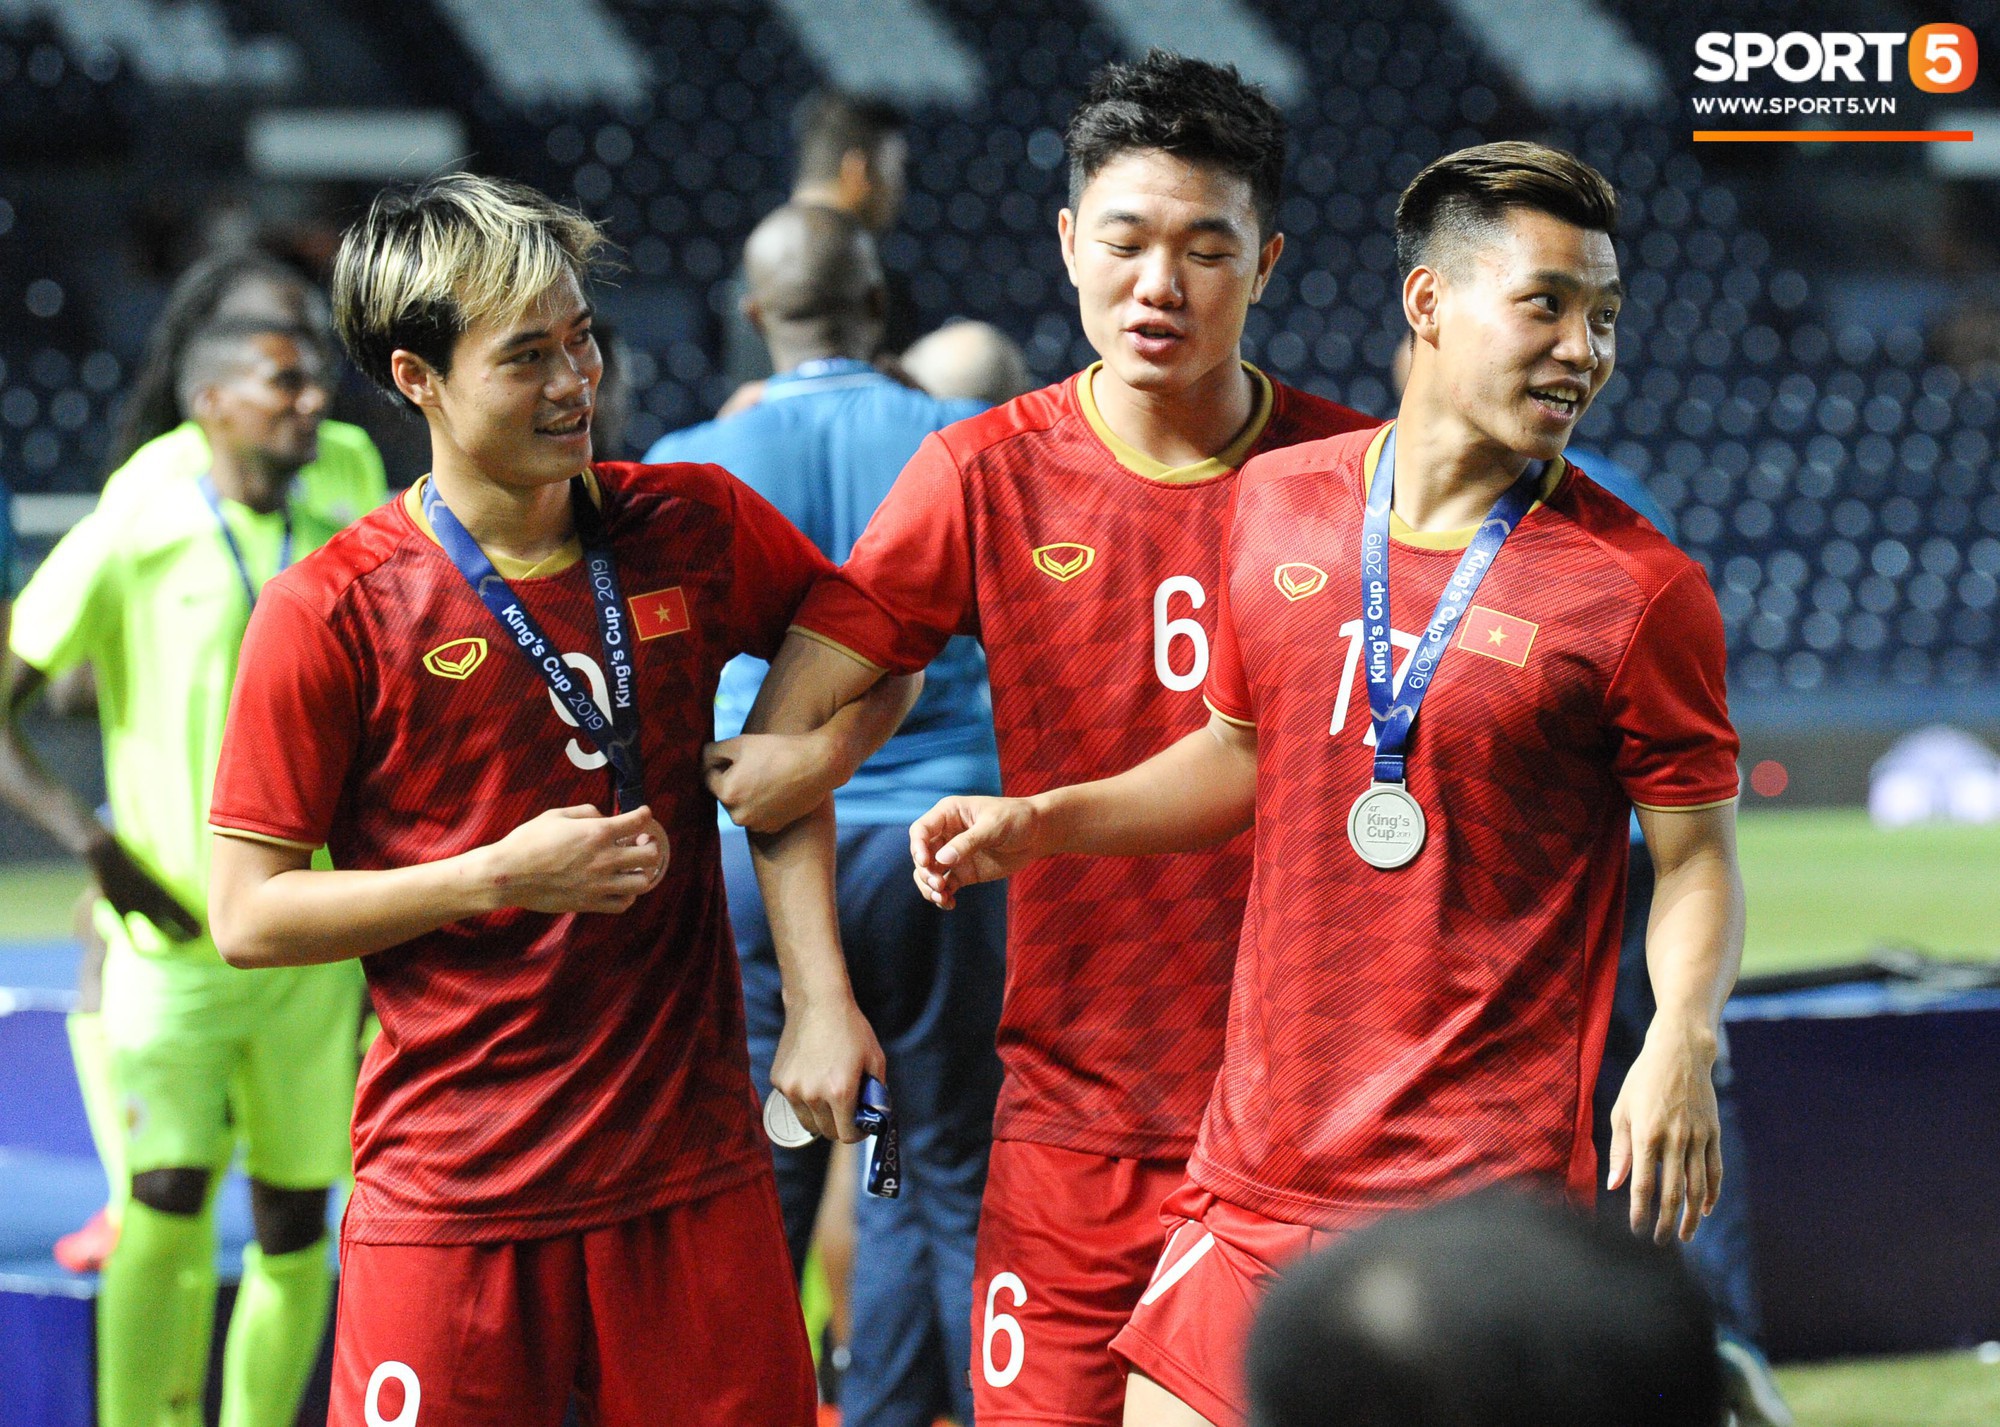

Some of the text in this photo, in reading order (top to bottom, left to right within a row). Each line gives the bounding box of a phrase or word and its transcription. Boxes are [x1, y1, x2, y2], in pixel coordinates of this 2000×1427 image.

[1366, 533, 1382, 575] 2019
[591, 559, 615, 602] 2019
[1367, 580, 1386, 620] Cup
[605, 606, 621, 645] Cup
[1153, 575, 1209, 692] 6
[1428, 605, 1458, 643] Cup
[1408, 648, 1437, 689] 2019
[542, 656, 573, 693] Cup
[567, 691, 605, 731] 2019
[548, 652, 614, 771] 9
[1366, 825, 1395, 841] Cup
[982, 1271, 1028, 1388] 6
